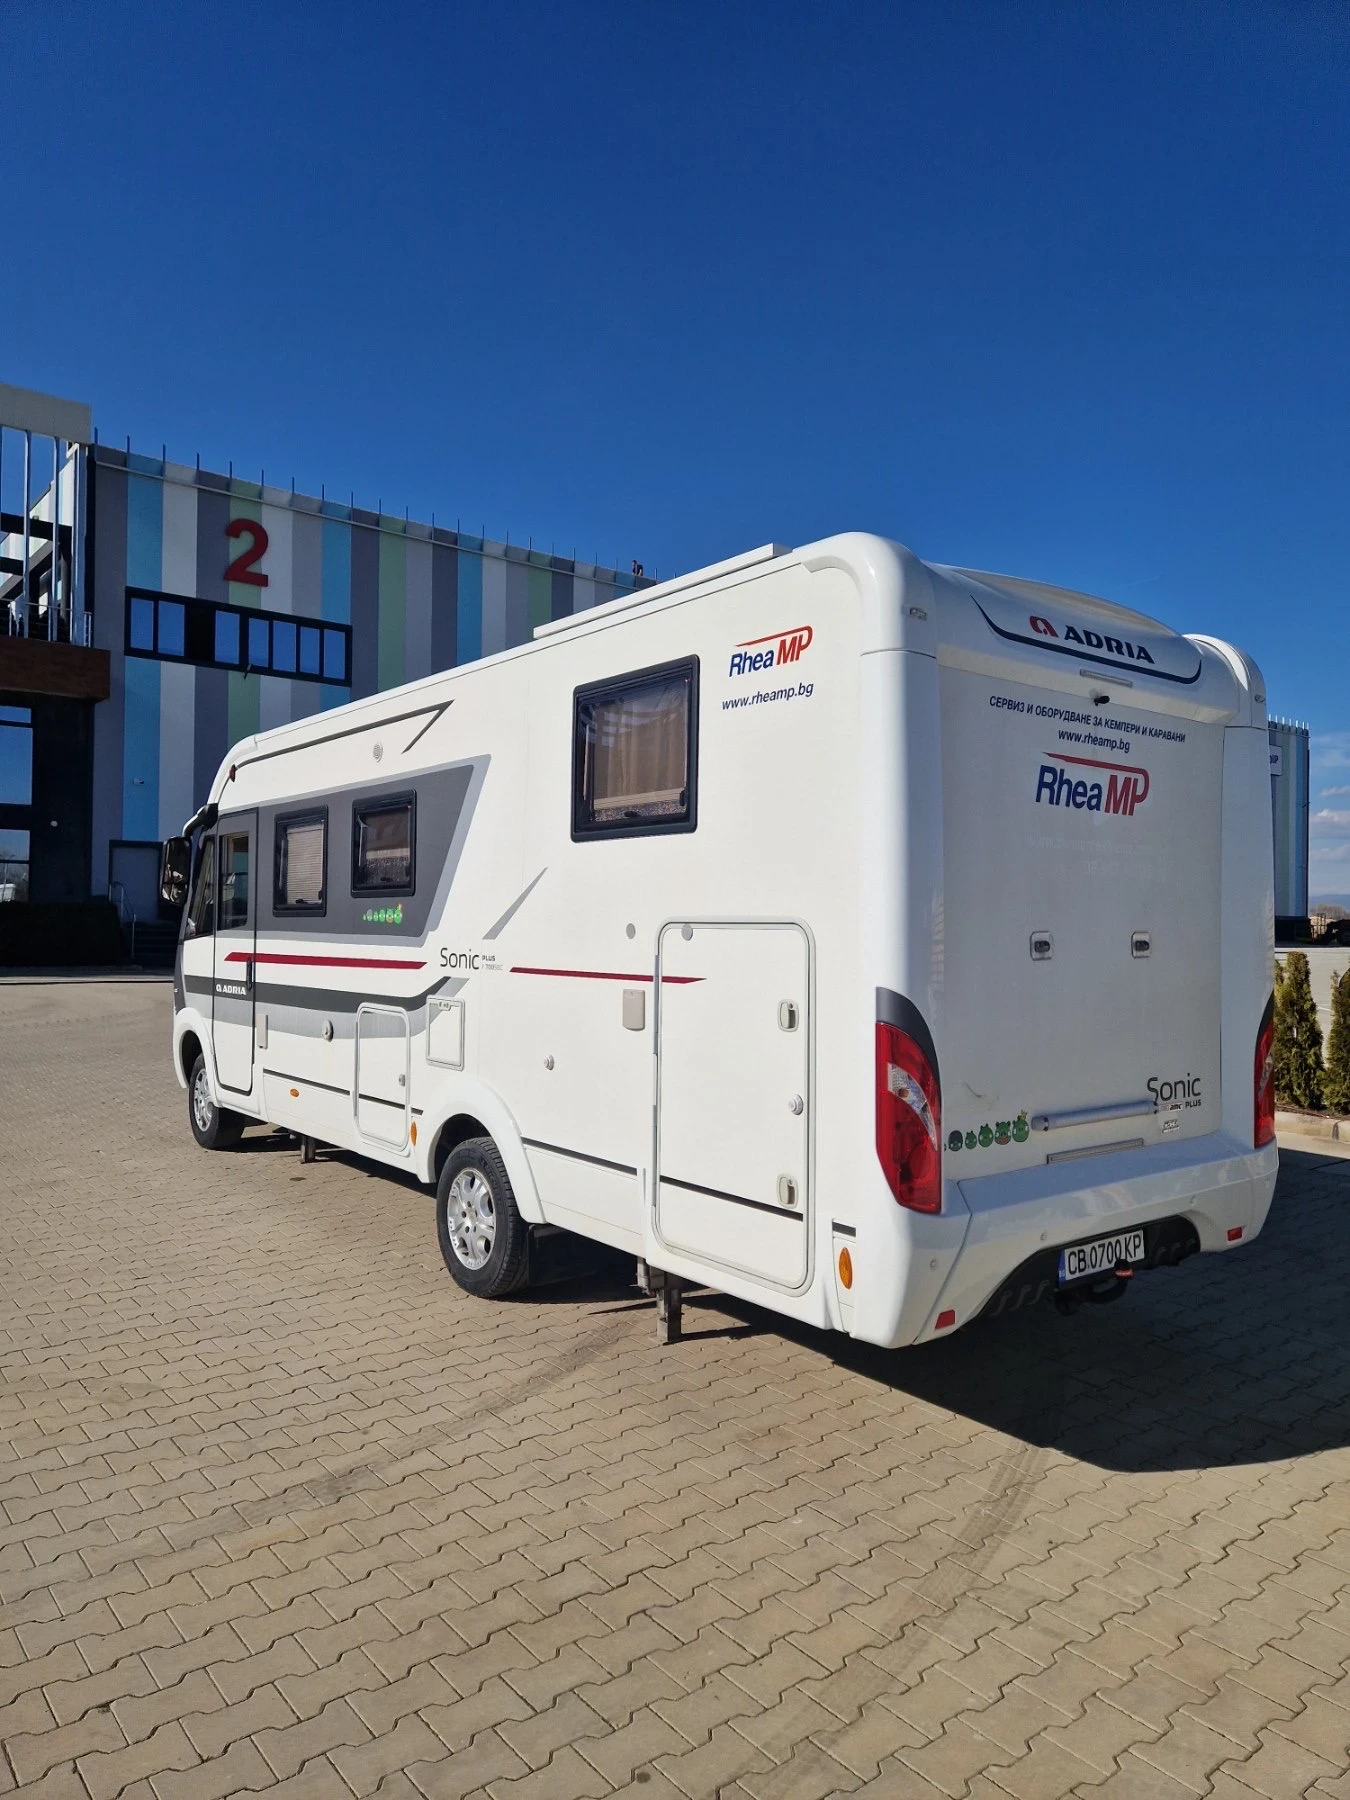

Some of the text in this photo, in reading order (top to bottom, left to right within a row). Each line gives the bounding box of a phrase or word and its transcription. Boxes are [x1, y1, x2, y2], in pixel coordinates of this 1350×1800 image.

[224, 518, 269, 587] 2
[1064, 625, 1155, 664] ADRIA
[722, 682, 814, 710] www.rheamp.bg
[989, 695, 1186, 743] СЕРВИЗ И ОБОРУДВАНЕ ЗА КЕМПЕРИ И КАРАВАНИ
[1058, 728, 1131, 753] www.rheamp.bg
[440, 947, 480, 970] Sonic
[222, 985, 247, 996] ADRIA
[1147, 1072, 1202, 1102] Sonic
[1184, 1099, 1202, 1109] PLUS
